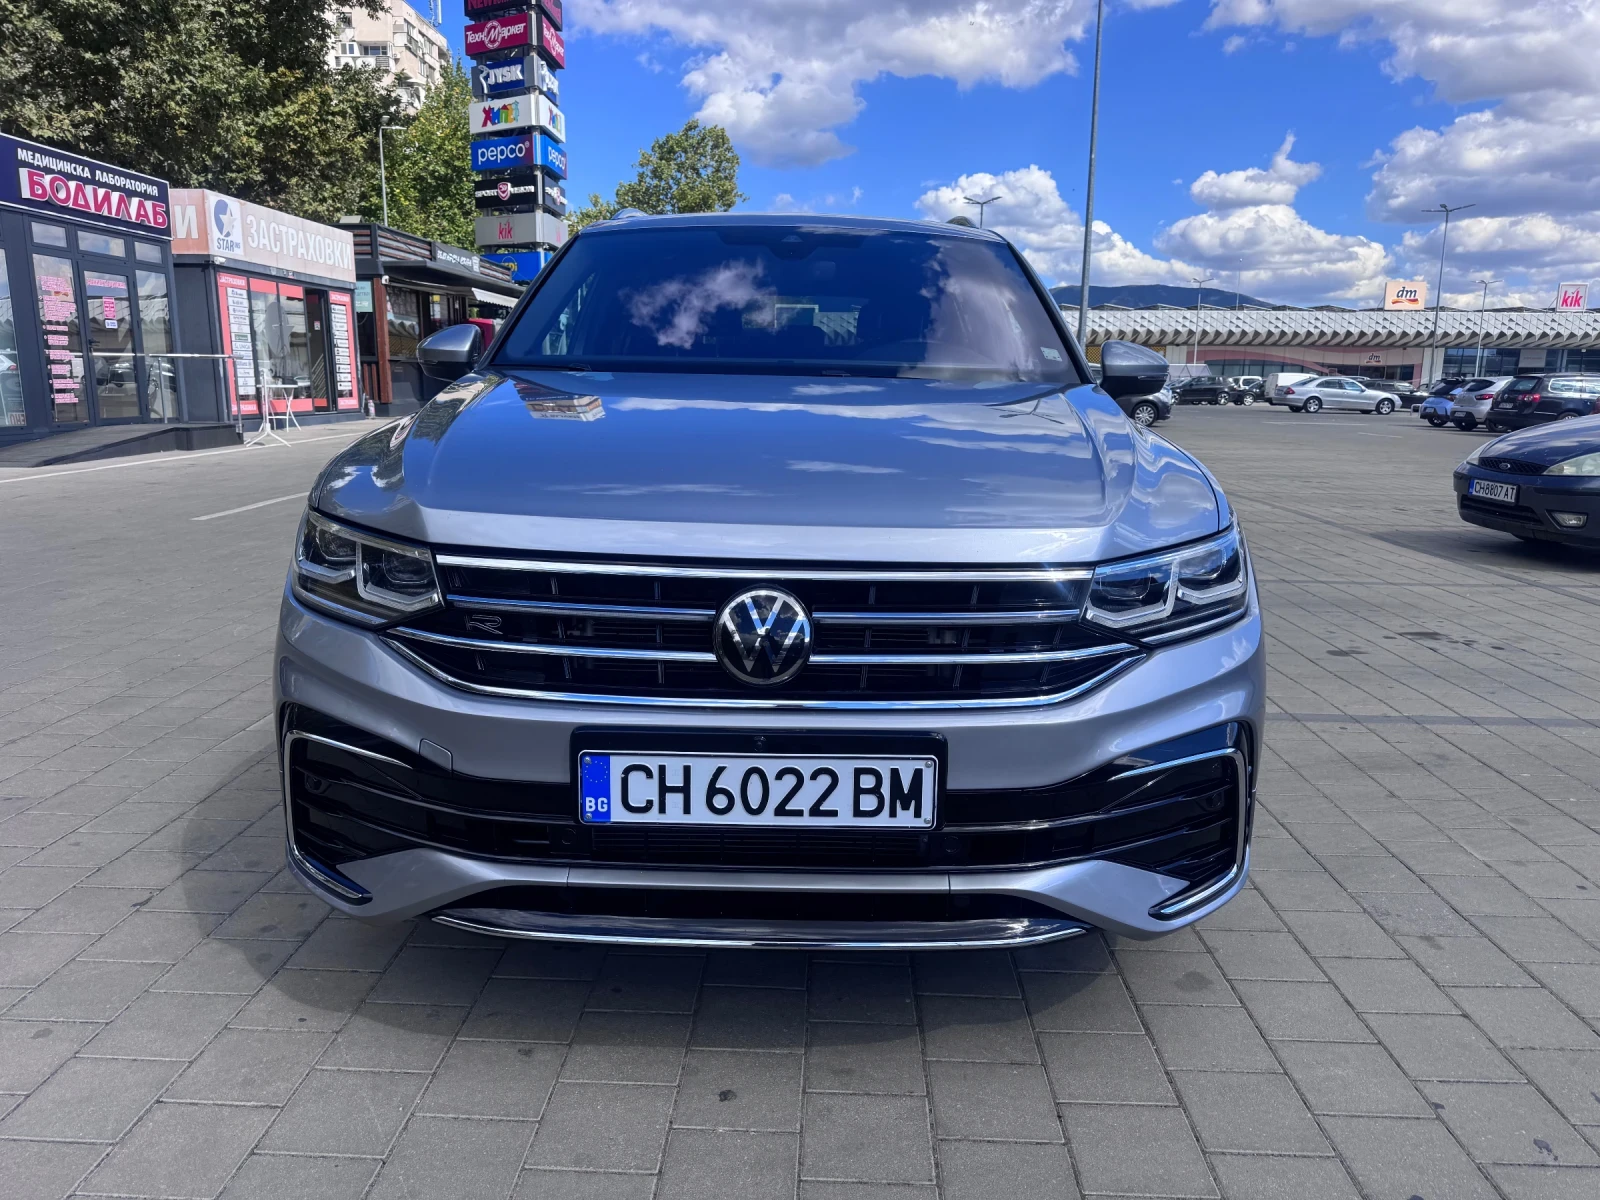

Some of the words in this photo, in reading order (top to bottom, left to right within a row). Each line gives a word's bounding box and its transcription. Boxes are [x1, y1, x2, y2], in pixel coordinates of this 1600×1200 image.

[487, 64, 523, 85] JYSK
[17, 148, 91, 179] МЕДИЦИНСКА
[95, 170, 159, 197] ЛАБОРАТОРИЯ
[24, 168, 168, 229] БОДИЛАБ
[475, 189, 498, 198] SPORT
[498, 221, 513, 240] kik
[216, 237, 235, 252] STAR
[246, 213, 353, 271] ЗАСТРАХОВКИ
[1396, 286, 1418, 299] dm
[1560, 287, 1584, 308] kik
[705, 765, 839, 817] 6022
[585, 796, 608, 813] BG
